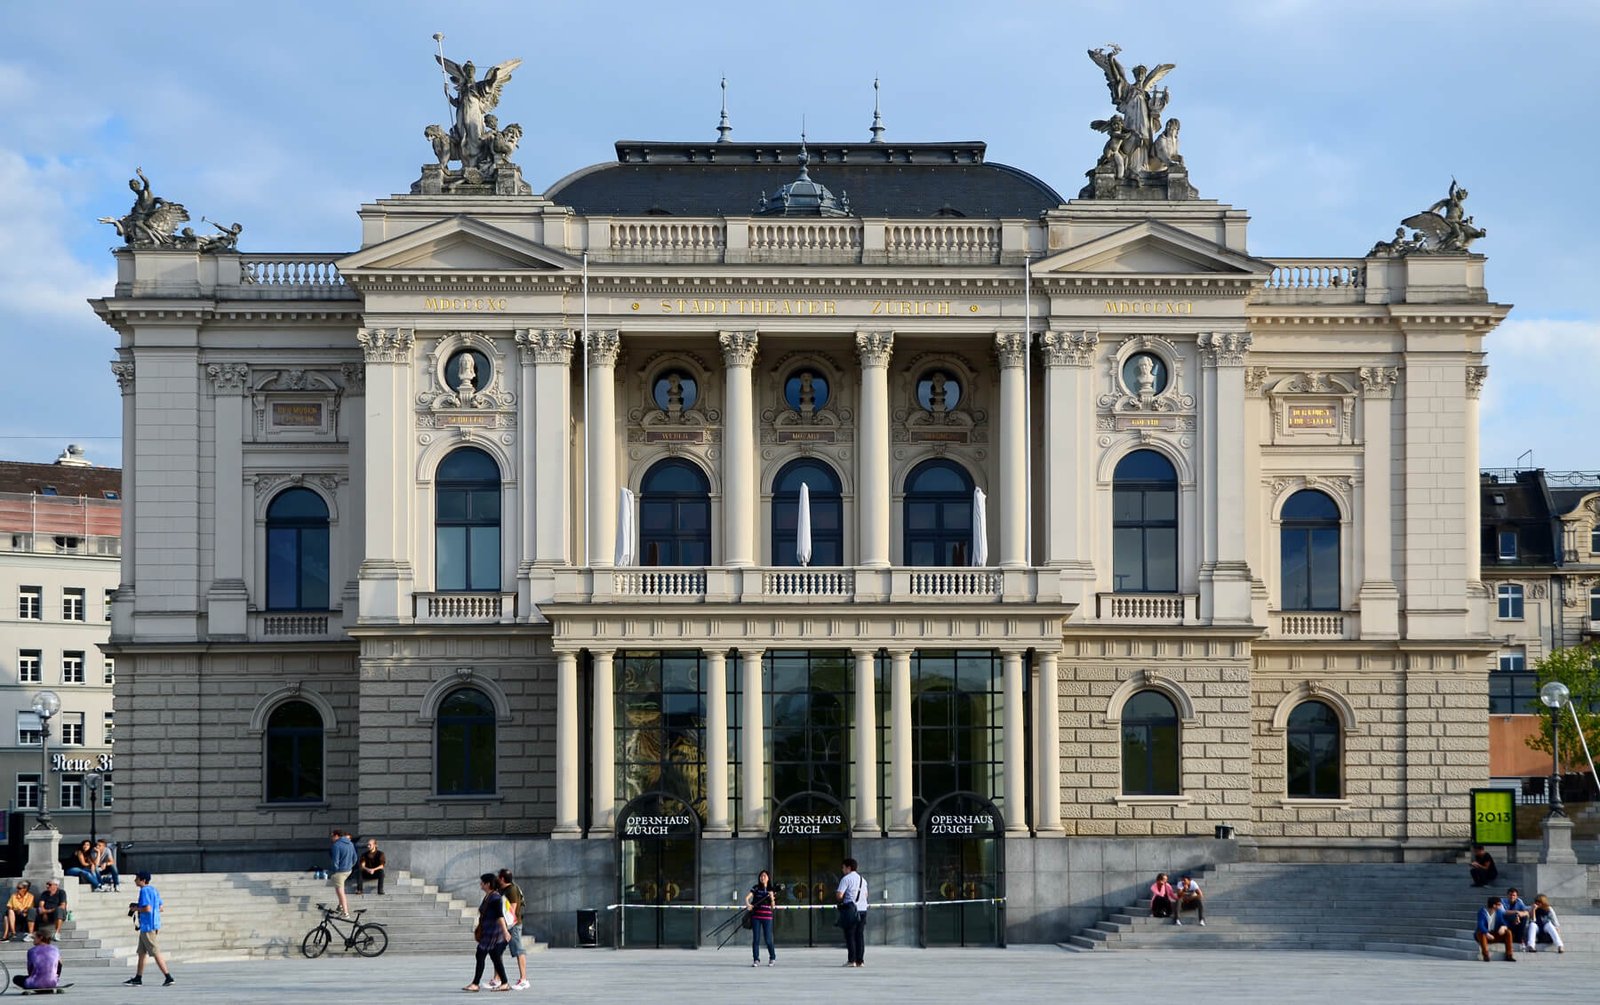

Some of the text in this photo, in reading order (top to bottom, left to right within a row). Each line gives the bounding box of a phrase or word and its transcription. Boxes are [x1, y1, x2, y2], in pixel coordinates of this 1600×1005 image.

[424, 297, 508, 311] MDCCCXC
[660, 299, 837, 314] STADTTHEATER
[1103, 300, 1193, 315] MDCCCXCI
[52, 753, 92, 771] Neue
[626, 815, 689, 824] OPERNHAUS
[778, 814, 842, 824] OPERNHAUS
[931, 814, 994, 824] OPERNHAUS
[1477, 811, 1511, 823] 2013
[626, 824, 668, 834] ZÜRICH
[778, 824, 820, 834] ZÜRICH
[931, 824, 973, 834] ZÜRICH
